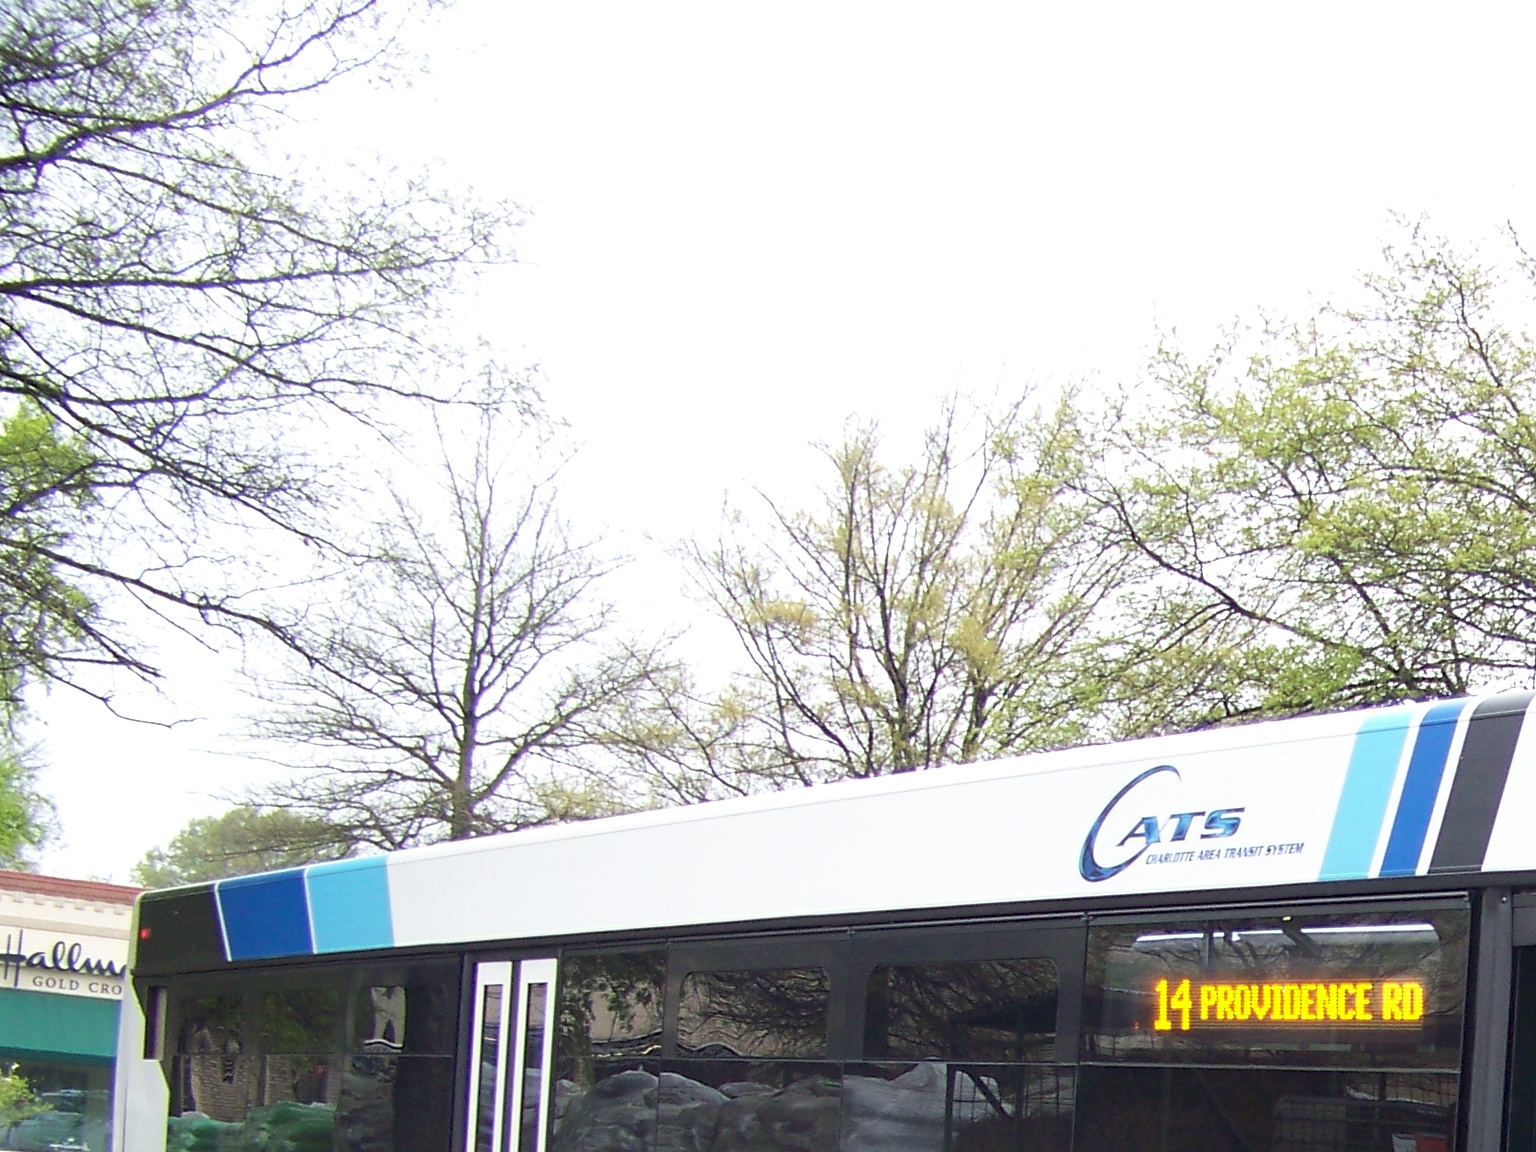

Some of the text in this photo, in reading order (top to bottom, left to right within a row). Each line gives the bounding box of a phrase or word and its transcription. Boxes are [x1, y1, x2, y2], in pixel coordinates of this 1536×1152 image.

[1079, 764, 1245, 882] CATS
[1145, 842, 1304, 865] CHARLOTTE AREA TRANSIT SYSTEM
[32, 975, 80, 991] GOLD
[1154, 979, 1424, 1030] 14 PROVIDENCE RD
